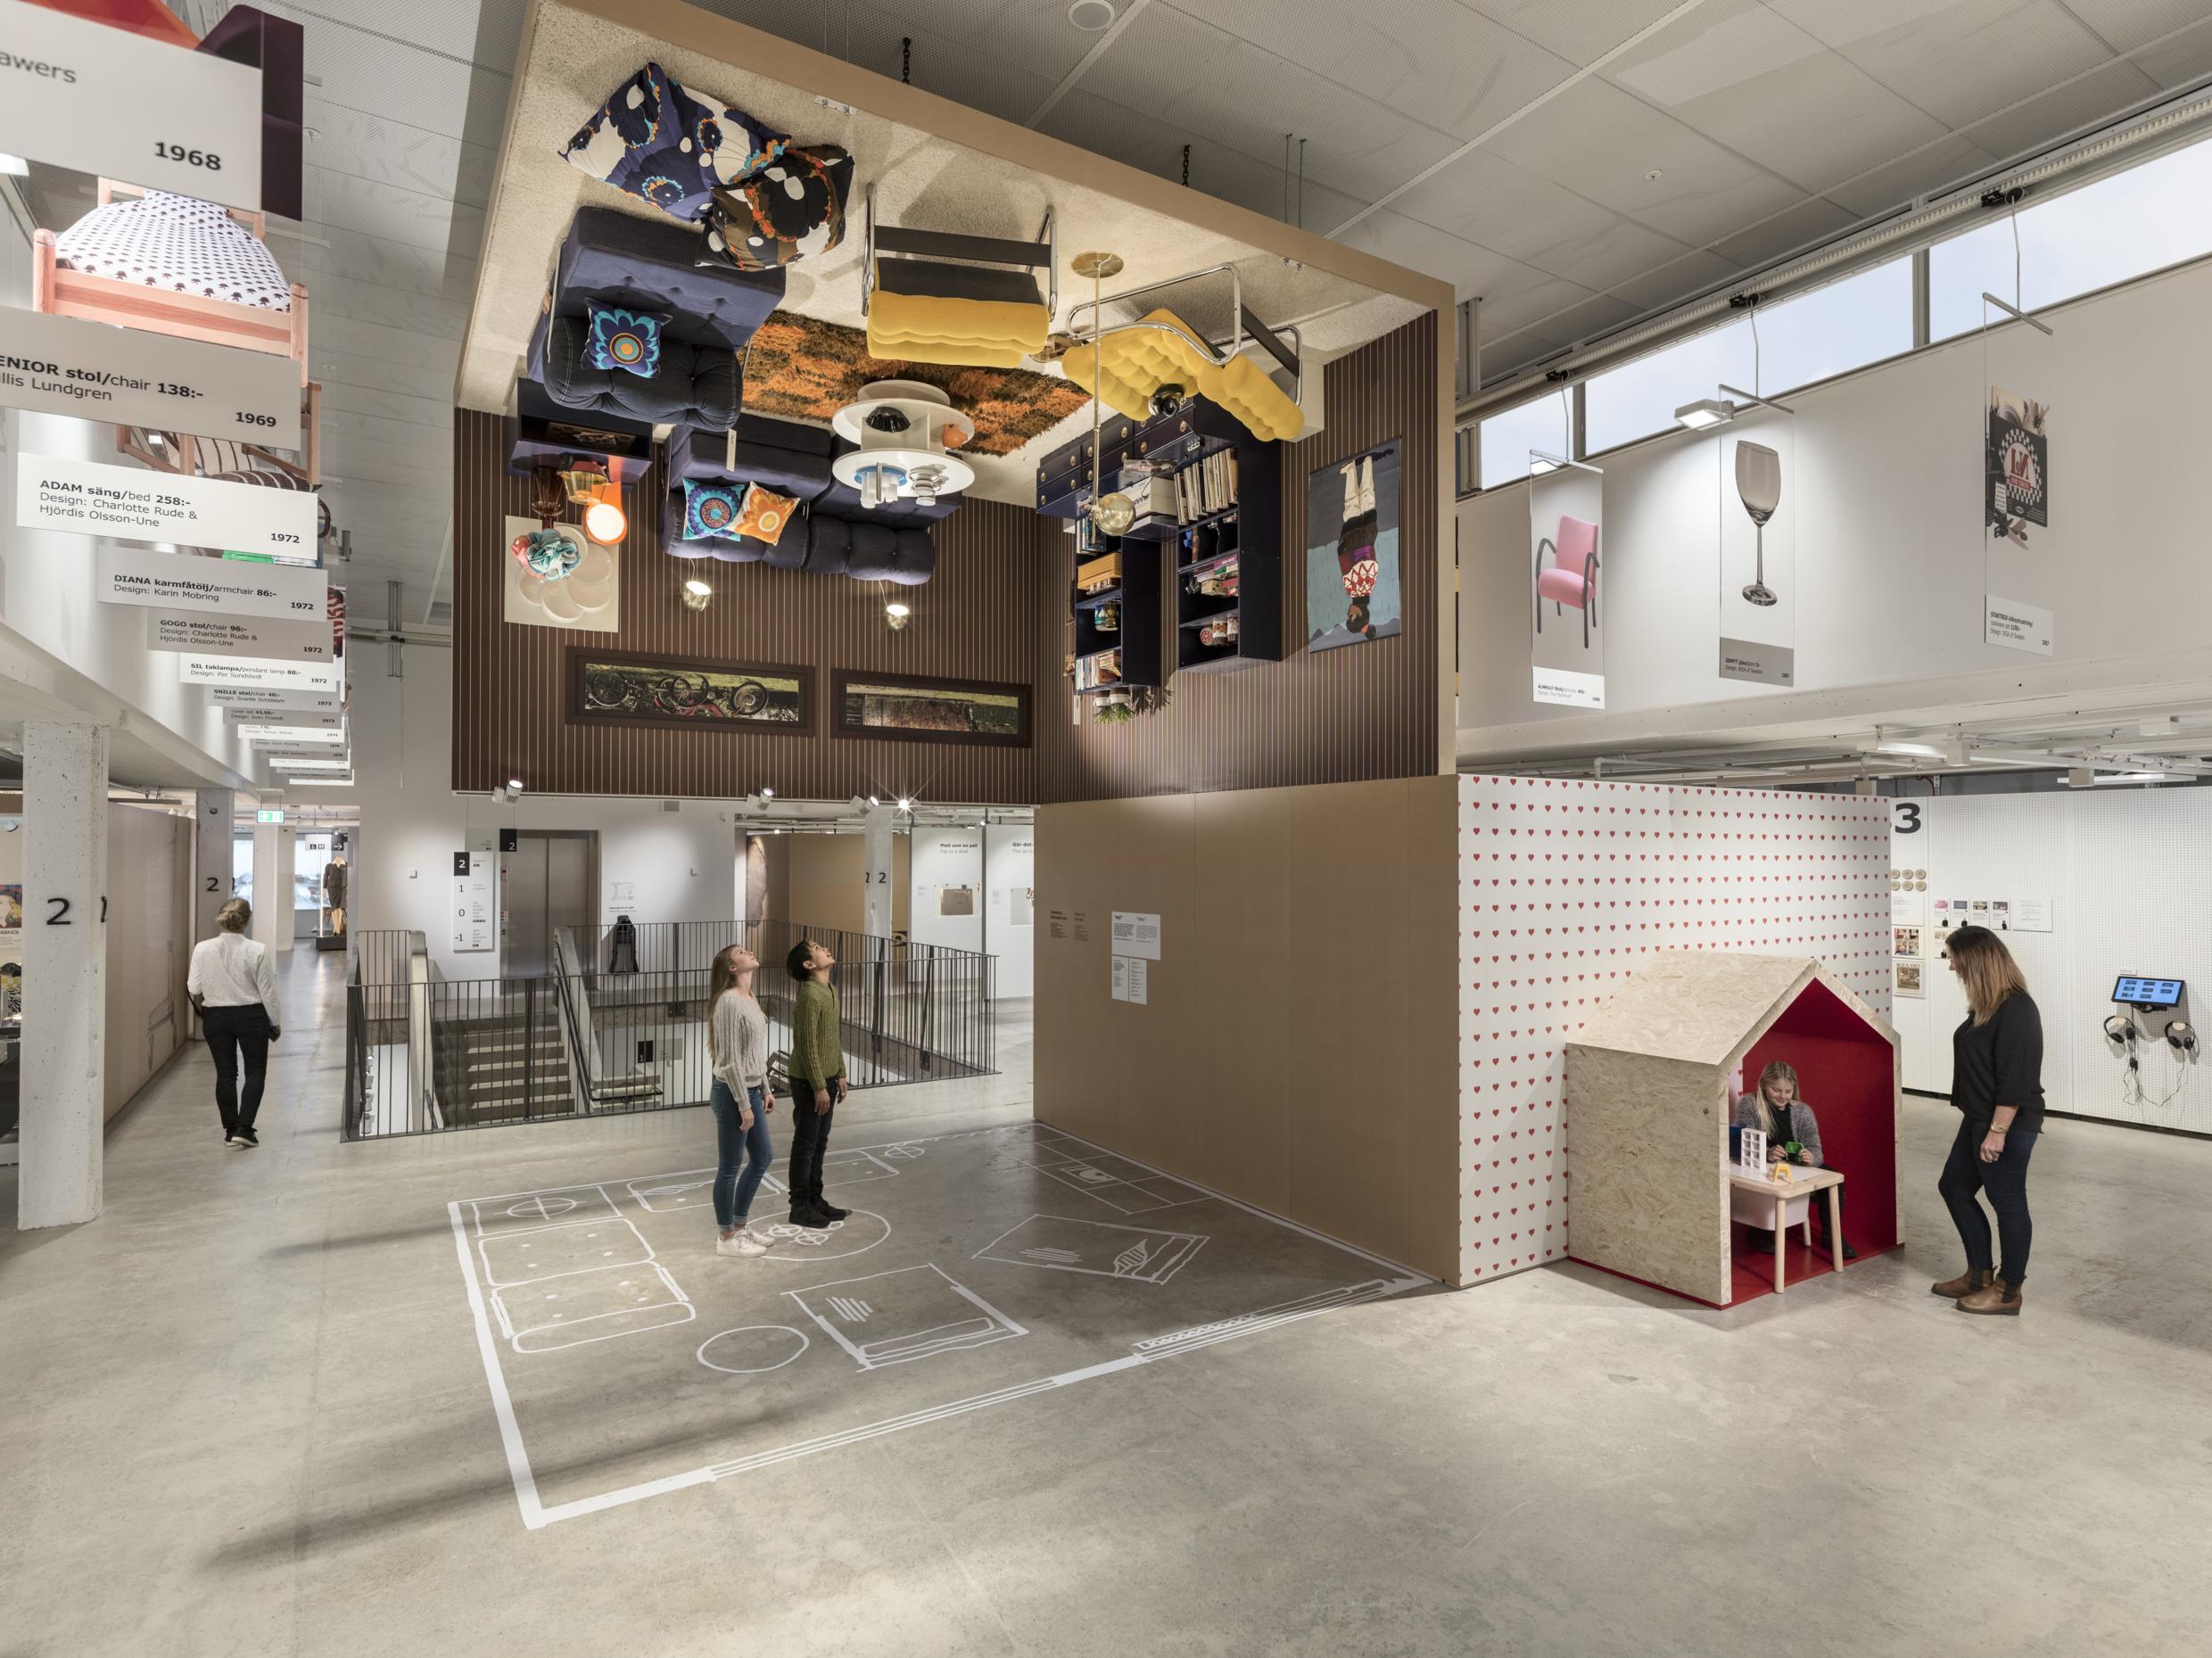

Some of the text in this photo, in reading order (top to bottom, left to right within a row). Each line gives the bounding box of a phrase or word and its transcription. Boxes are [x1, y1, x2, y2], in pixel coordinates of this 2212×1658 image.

[0, 51, 77, 84] awers
[154, 141, 222, 171] 1968
[32, 377, 112, 401] Lundgren
[65, 367, 151, 391] stol/chair
[157, 382, 204, 399] 138:-
[235, 411, 277, 427] 1969
[39, 480, 191, 507] ADAM säng/bed 258:-
[39, 491, 198, 520] Design: Charlotte Rude &
[39, 504, 160, 527] Hjördis Olsson-Une
[270, 532, 301, 544] 1972
[114, 574, 277, 598] DIANA karmfåtölj/armchair 86:-
[114, 584, 219, 602] Design: Karin Mobring
[290, 601, 315, 611] 1972
[160, 619, 187, 628] GOGO
[189, 622, 227, 631] stol/chair
[160, 627, 189, 636] Design:
[192, 630, 228, 639] Charlotte
[160, 635, 235, 647] Hjördis Olsson-Une
[302, 646, 323, 654] 1972
[190, 669, 215, 678] Design:
[1894, 802, 1921, 834] 3
[508, 842, 516, 851] 2
[458, 859, 466, 869] 2
[206, 877, 219, 892] 2
[878, 871, 887, 884] 2
[458, 884, 465, 893] 1
[46, 897, 71, 926] 2
[458, 908, 466, 918] 0
[454, 933, 464, 942] -1
